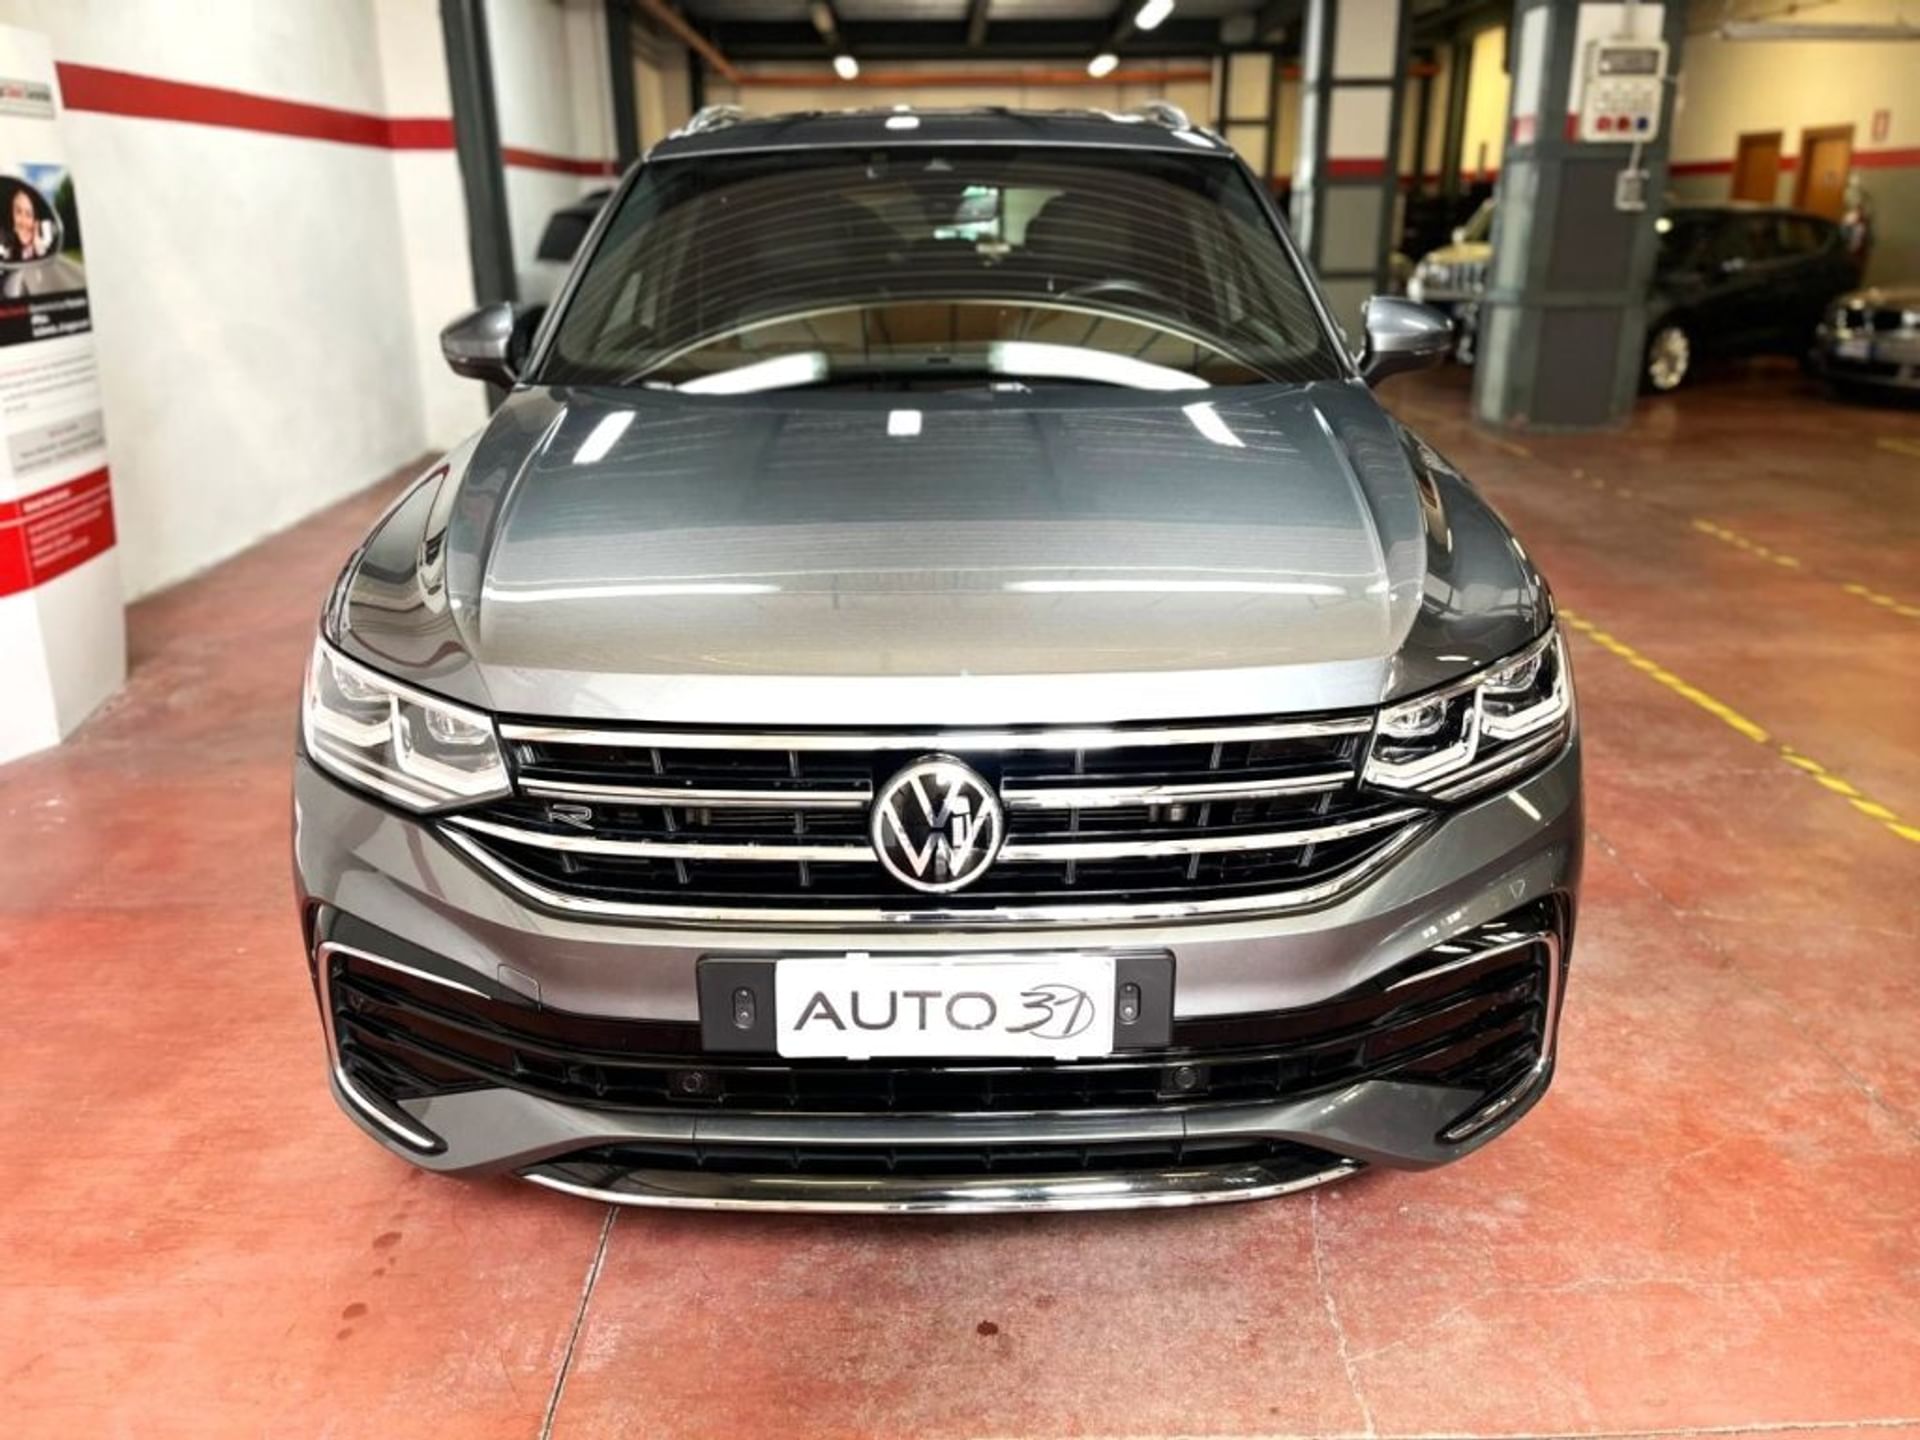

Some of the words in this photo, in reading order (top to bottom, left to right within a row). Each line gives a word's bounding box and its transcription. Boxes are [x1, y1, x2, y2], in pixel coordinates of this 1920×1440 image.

[548, 804, 595, 830] R
[793, 991, 997, 1031] AUTO
[1005, 990, 1088, 1034] 31
